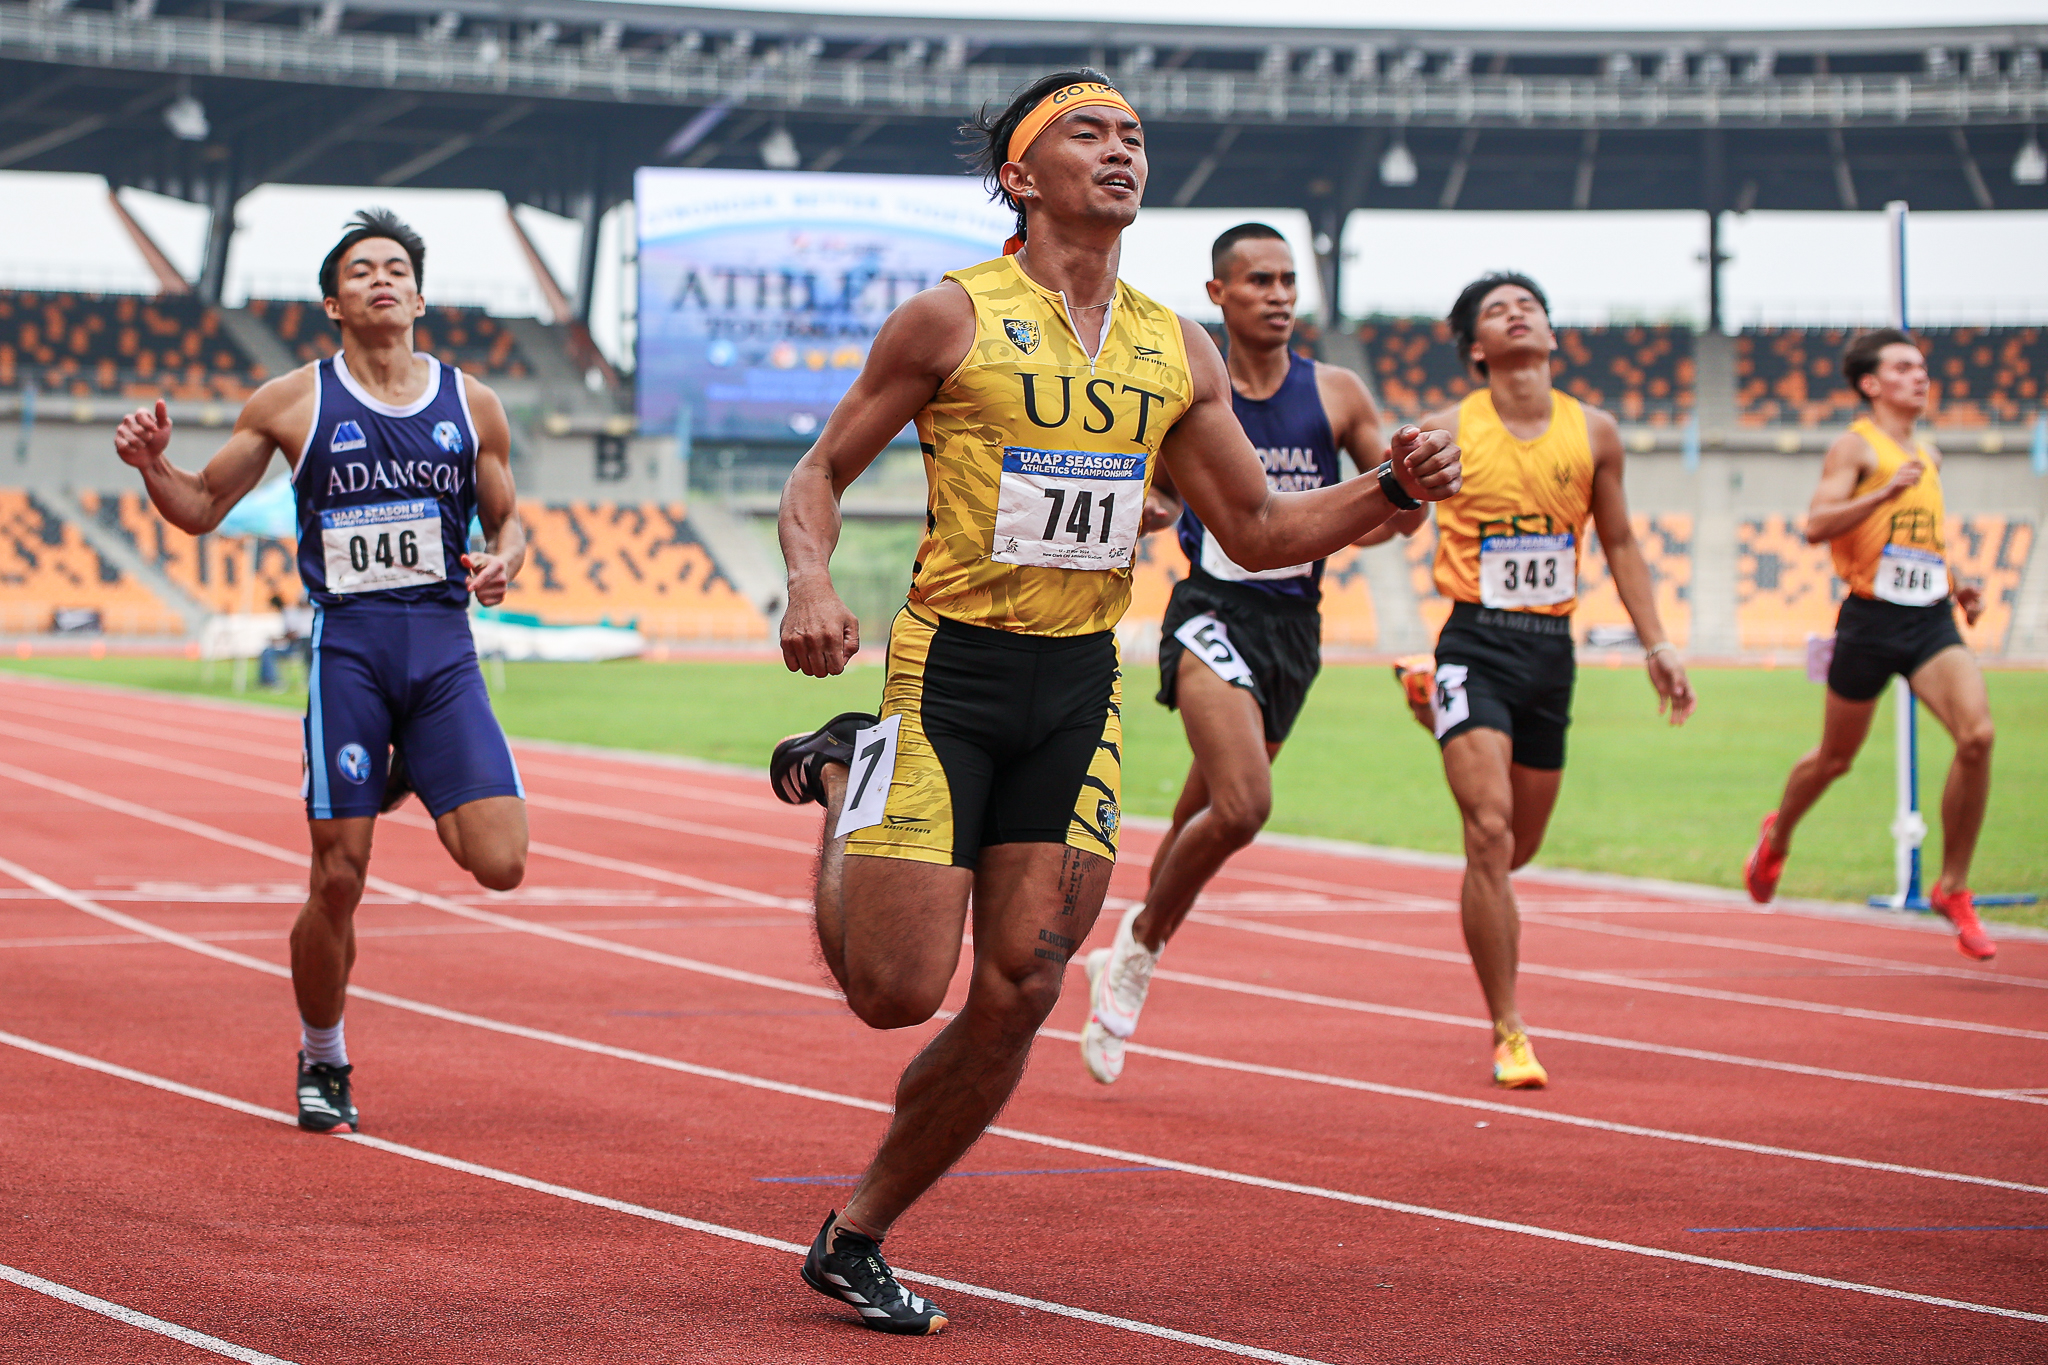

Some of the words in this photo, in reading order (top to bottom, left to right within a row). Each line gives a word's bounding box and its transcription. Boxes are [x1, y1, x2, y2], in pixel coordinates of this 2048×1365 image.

[1053, 85, 1084, 104] GO
[1014, 373, 1165, 447] UST
[328, 460, 465, 496] ADAMSON
[1020, 451, 1063, 466] UAAP
[1065, 455, 1123, 470] SEASON
[1123, 458, 1136, 470] 87
[1021, 463, 1070, 475] ATHLETICS
[1071, 467, 1133, 478] CHAMPIONSHIPS
[331, 509, 363, 522] UAAP
[365, 504, 410, 517] SEASON
[1042, 488, 1115, 543] 741
[350, 530, 419, 572] 046
[1505, 558, 1556, 591] 343
[1193, 623, 1233, 662] 5
[848, 737, 887, 812] 7
